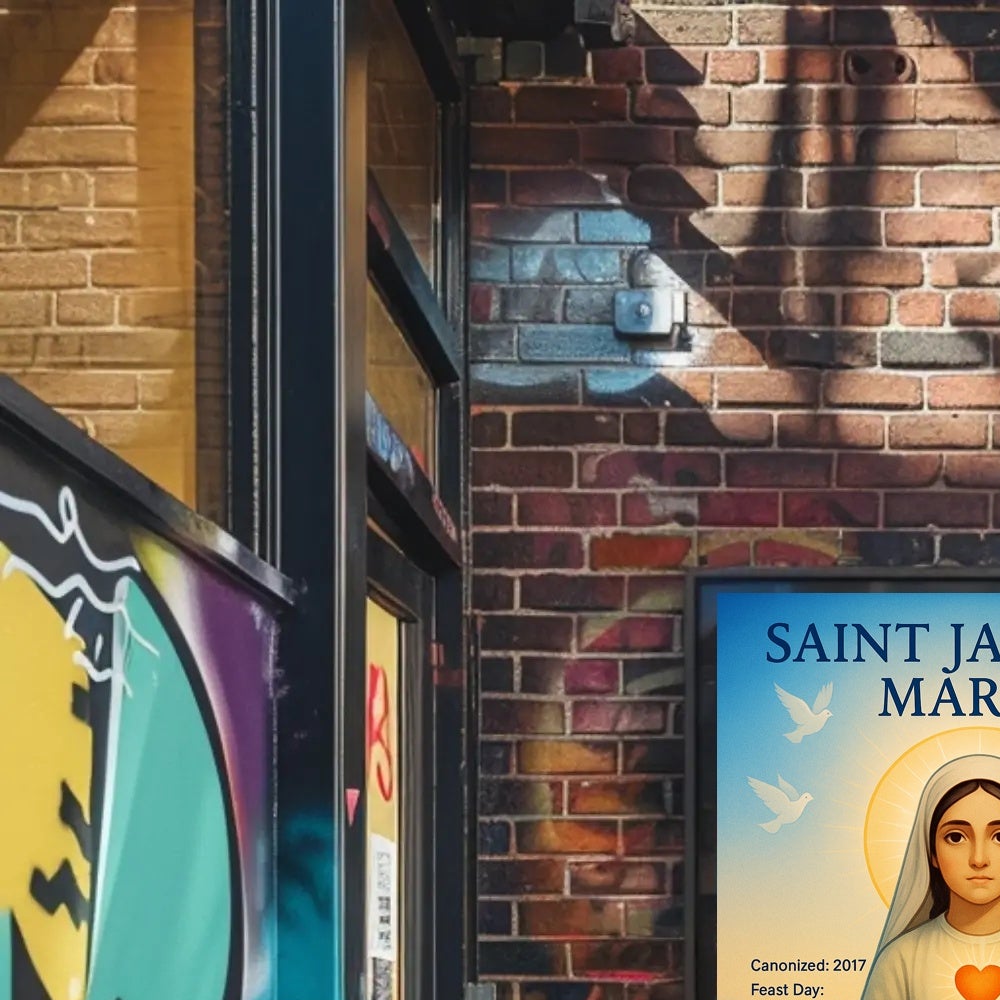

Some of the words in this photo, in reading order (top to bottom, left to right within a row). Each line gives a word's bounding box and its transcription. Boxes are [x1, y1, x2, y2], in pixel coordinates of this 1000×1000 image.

[765, 622, 929, 664] SAINT
[751, 959, 829, 971] Canonized:
[833, 959, 866, 971] 2017
[751, 983, 789, 996] Feast
[793, 983, 824, 998] Day:
